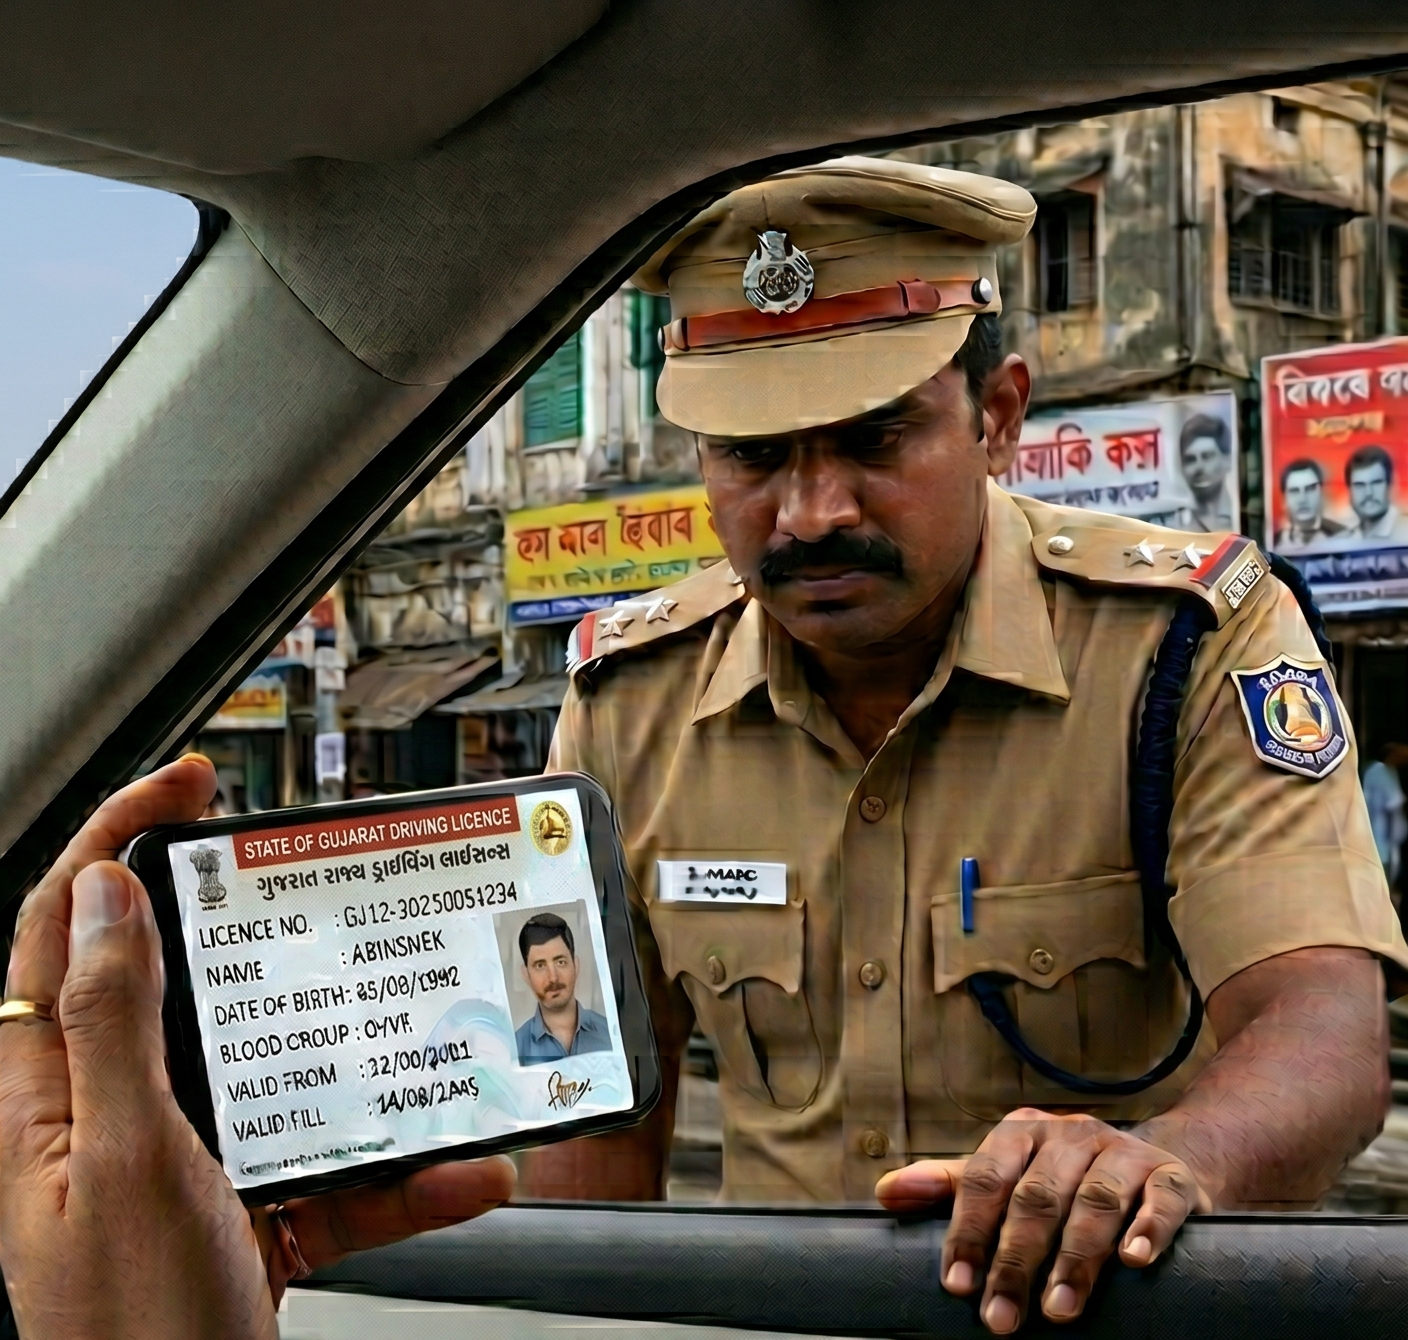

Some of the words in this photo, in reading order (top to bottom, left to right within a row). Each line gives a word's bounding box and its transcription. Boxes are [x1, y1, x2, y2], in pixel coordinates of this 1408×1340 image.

[244, 837, 290, 860] STATE
[294, 834, 314, 853] OF
[318, 824, 385, 850] GUJARAT
[391, 816, 448, 840] DRIVING
[451, 807, 511, 832] LICENCE
[257, 869, 319, 901] ગુજરાત
[324, 862, 366, 885] રાજ્ય
[198, 918, 274, 949] LICENCE
[279, 914, 313, 937] NO.
[206, 960, 265, 988] NAME
[214, 999, 260, 1026] DATE
[263, 994, 288, 1016] OF
[220, 1035, 283, 1064] BLOOD
[227, 1075, 279, 1103] VALID
[283, 1063, 337, 1093] FROM
[232, 1113, 286, 1142] VALID
